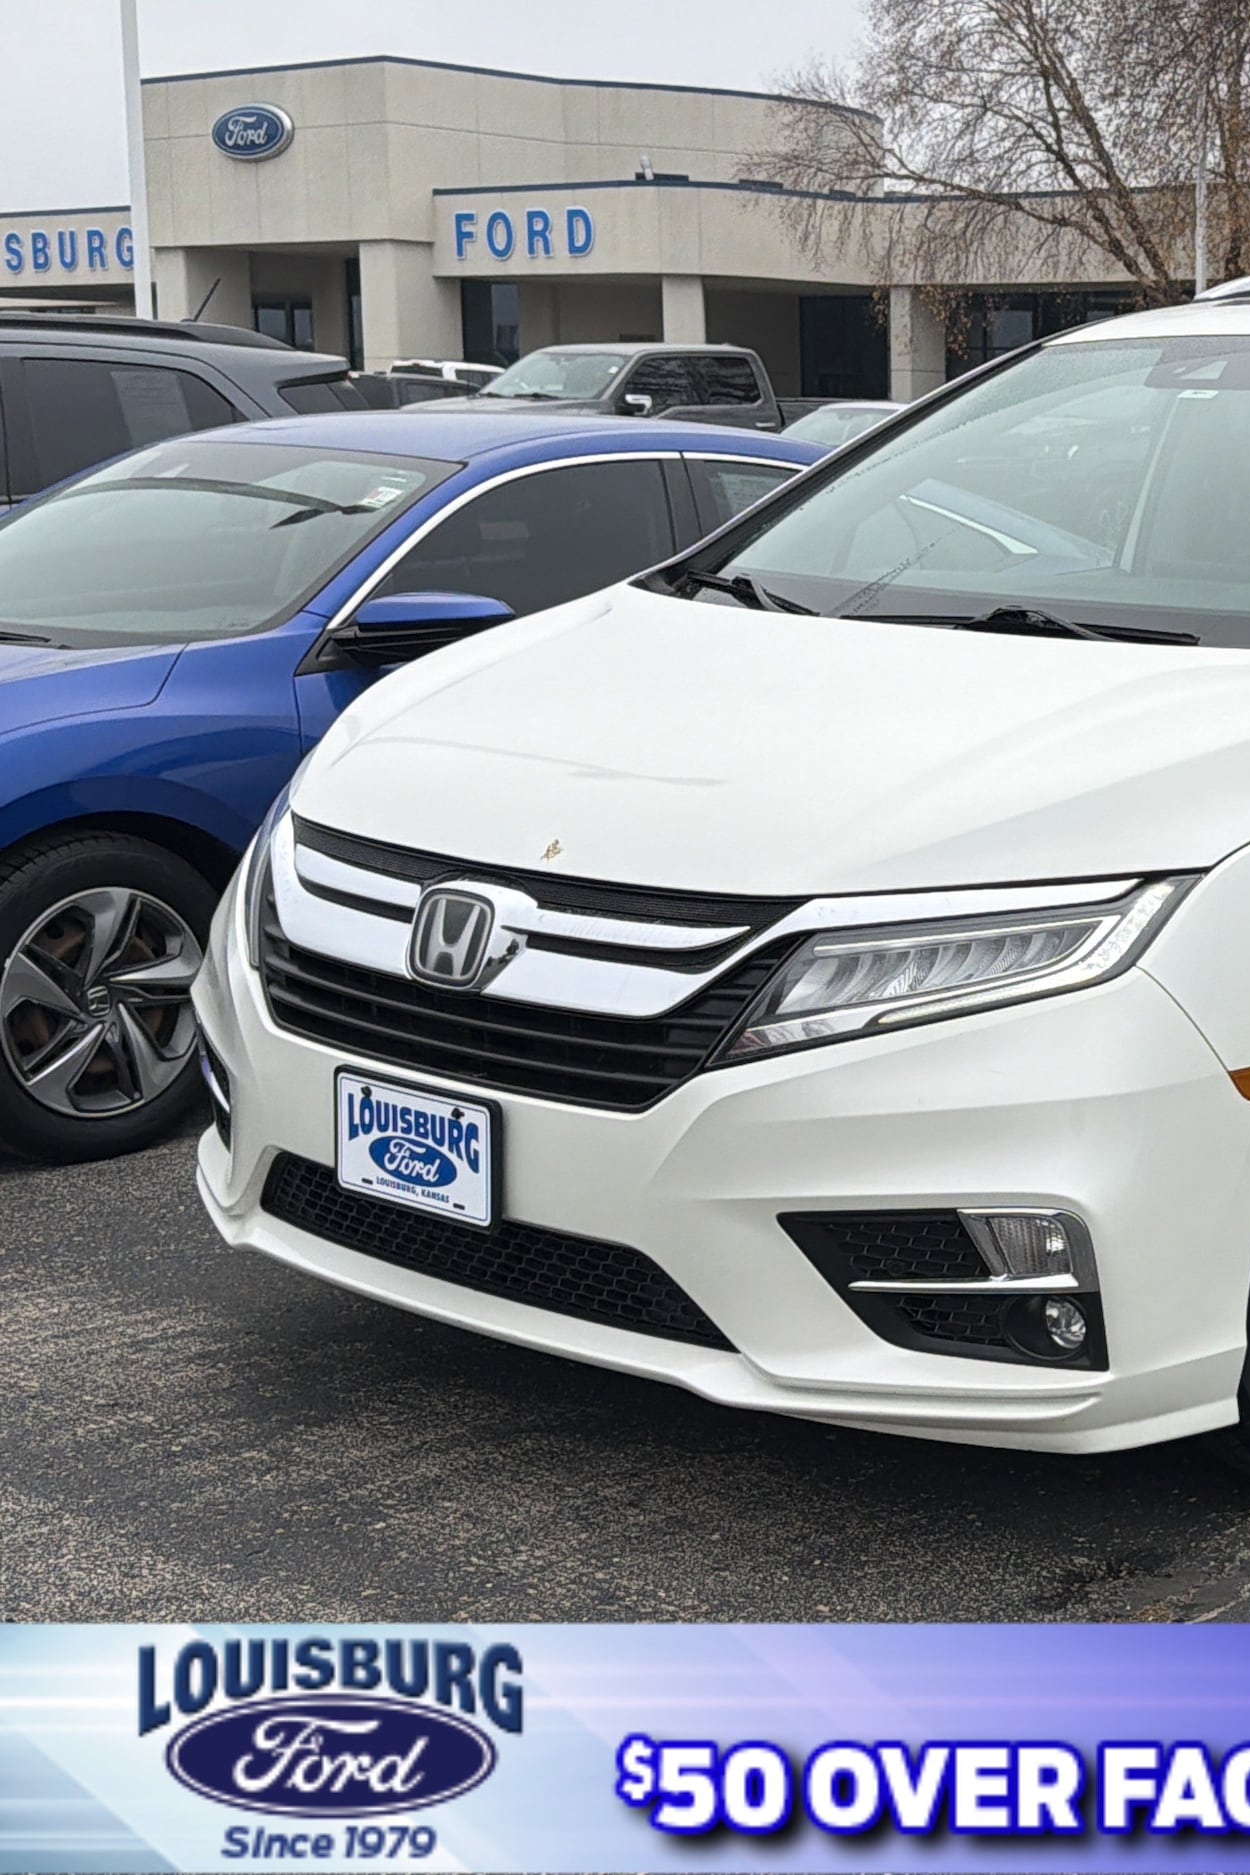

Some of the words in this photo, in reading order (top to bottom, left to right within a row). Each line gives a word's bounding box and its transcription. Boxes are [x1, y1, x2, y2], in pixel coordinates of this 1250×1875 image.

[225, 116, 268, 147] Ford
[4, 226, 134, 272] SBURG
[454, 207, 594, 259] FORD
[348, 1092, 479, 1174] LOUISBURG
[384, 1139, 440, 1182] Ford
[376, 1175, 419, 1197] LOUISBURG,
[421, 1187, 450, 1203] KANSAS
